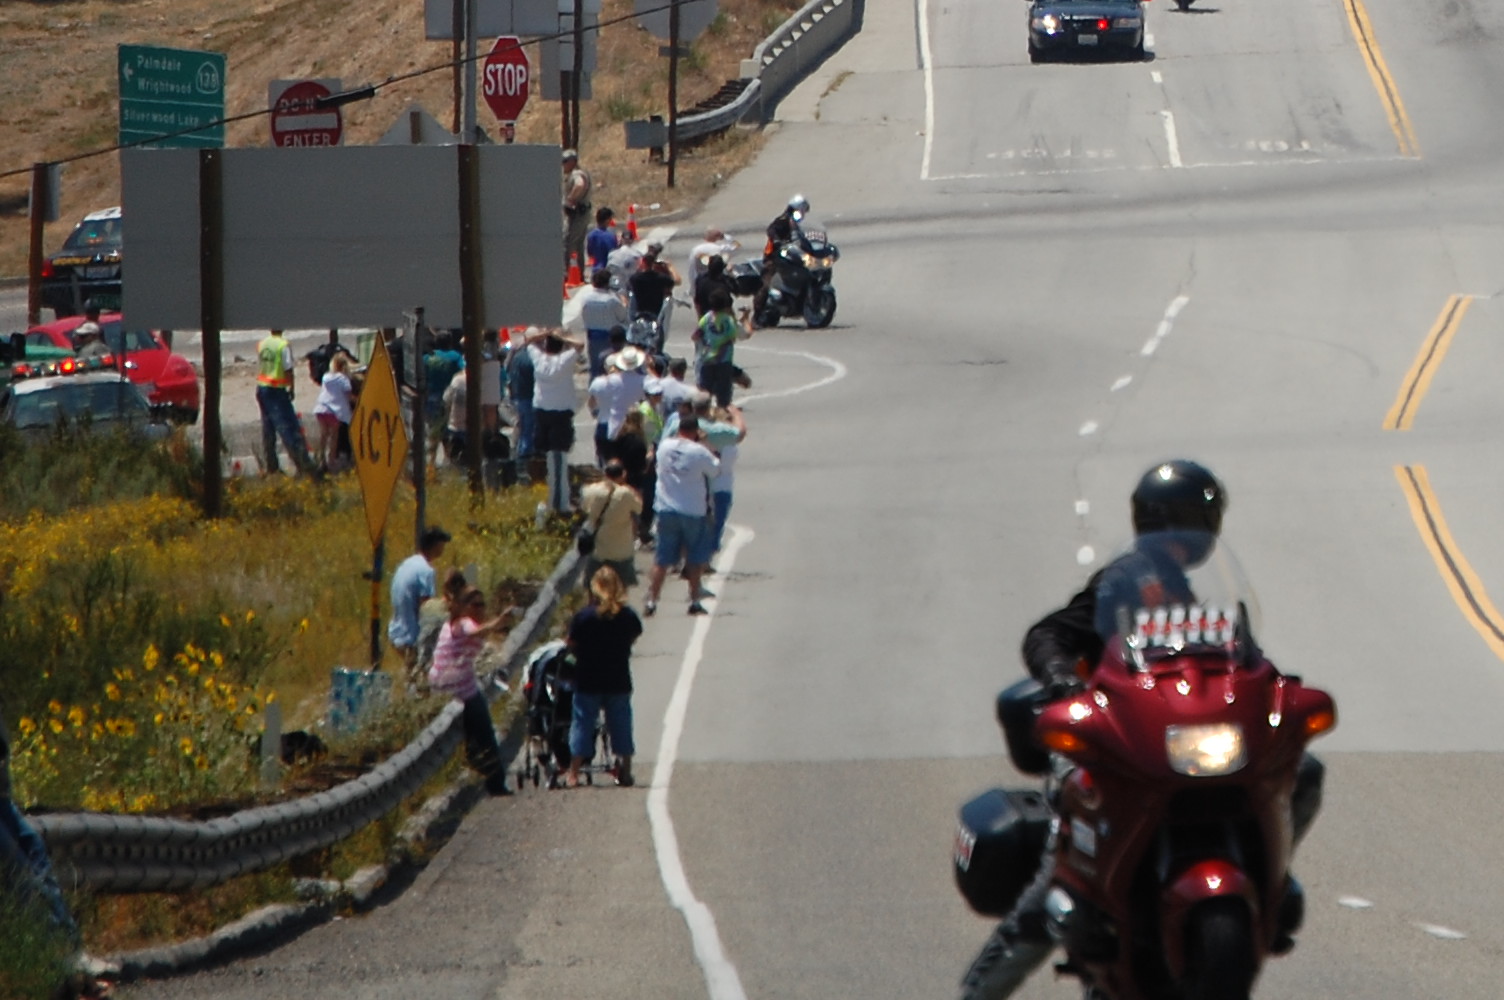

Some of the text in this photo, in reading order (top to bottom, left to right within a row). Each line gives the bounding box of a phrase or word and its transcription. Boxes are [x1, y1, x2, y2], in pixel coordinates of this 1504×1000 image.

[137, 55, 182, 72] Palmdale
[138, 77, 192, 94] Wrightwood
[485, 63, 527, 96] STOP
[123, 109, 176, 125] Silverwood
[284, 133, 331, 148] ENTER
[358, 405, 399, 467] ICY
